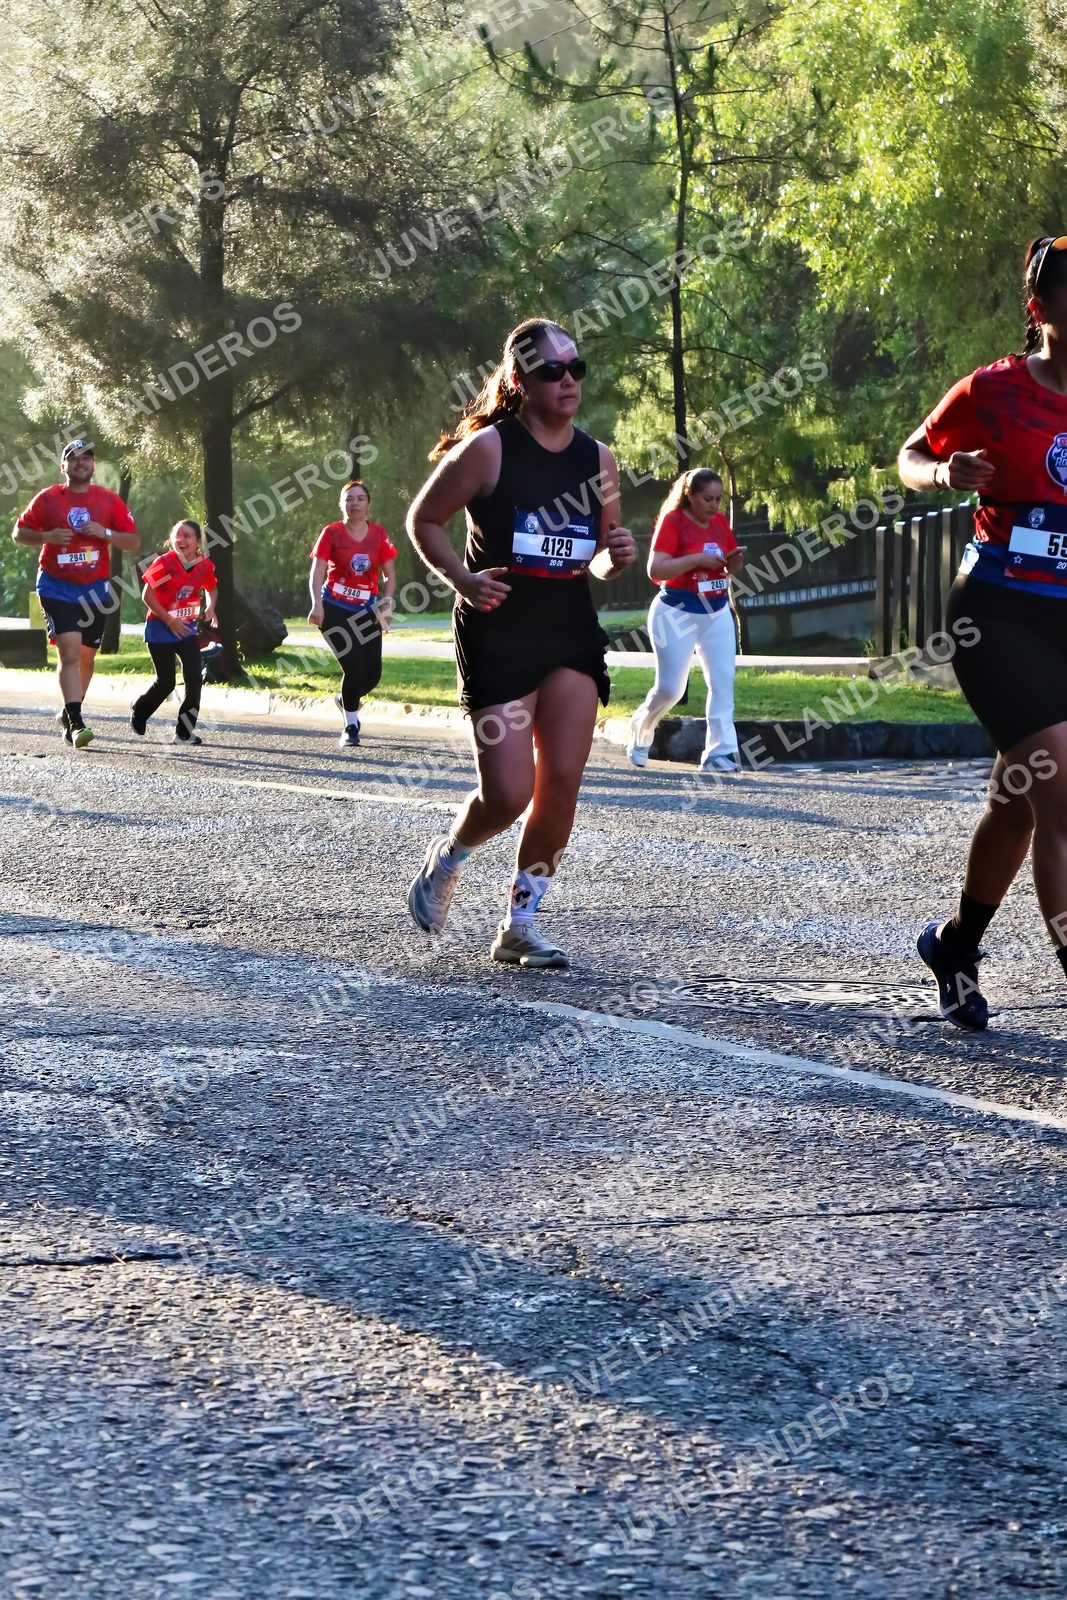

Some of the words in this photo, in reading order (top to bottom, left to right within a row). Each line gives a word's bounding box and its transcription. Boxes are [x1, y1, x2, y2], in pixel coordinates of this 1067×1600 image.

[540, 536, 573, 558] 4129
[69, 552, 86, 563] 2941
[343, 587, 361, 598] 2940
